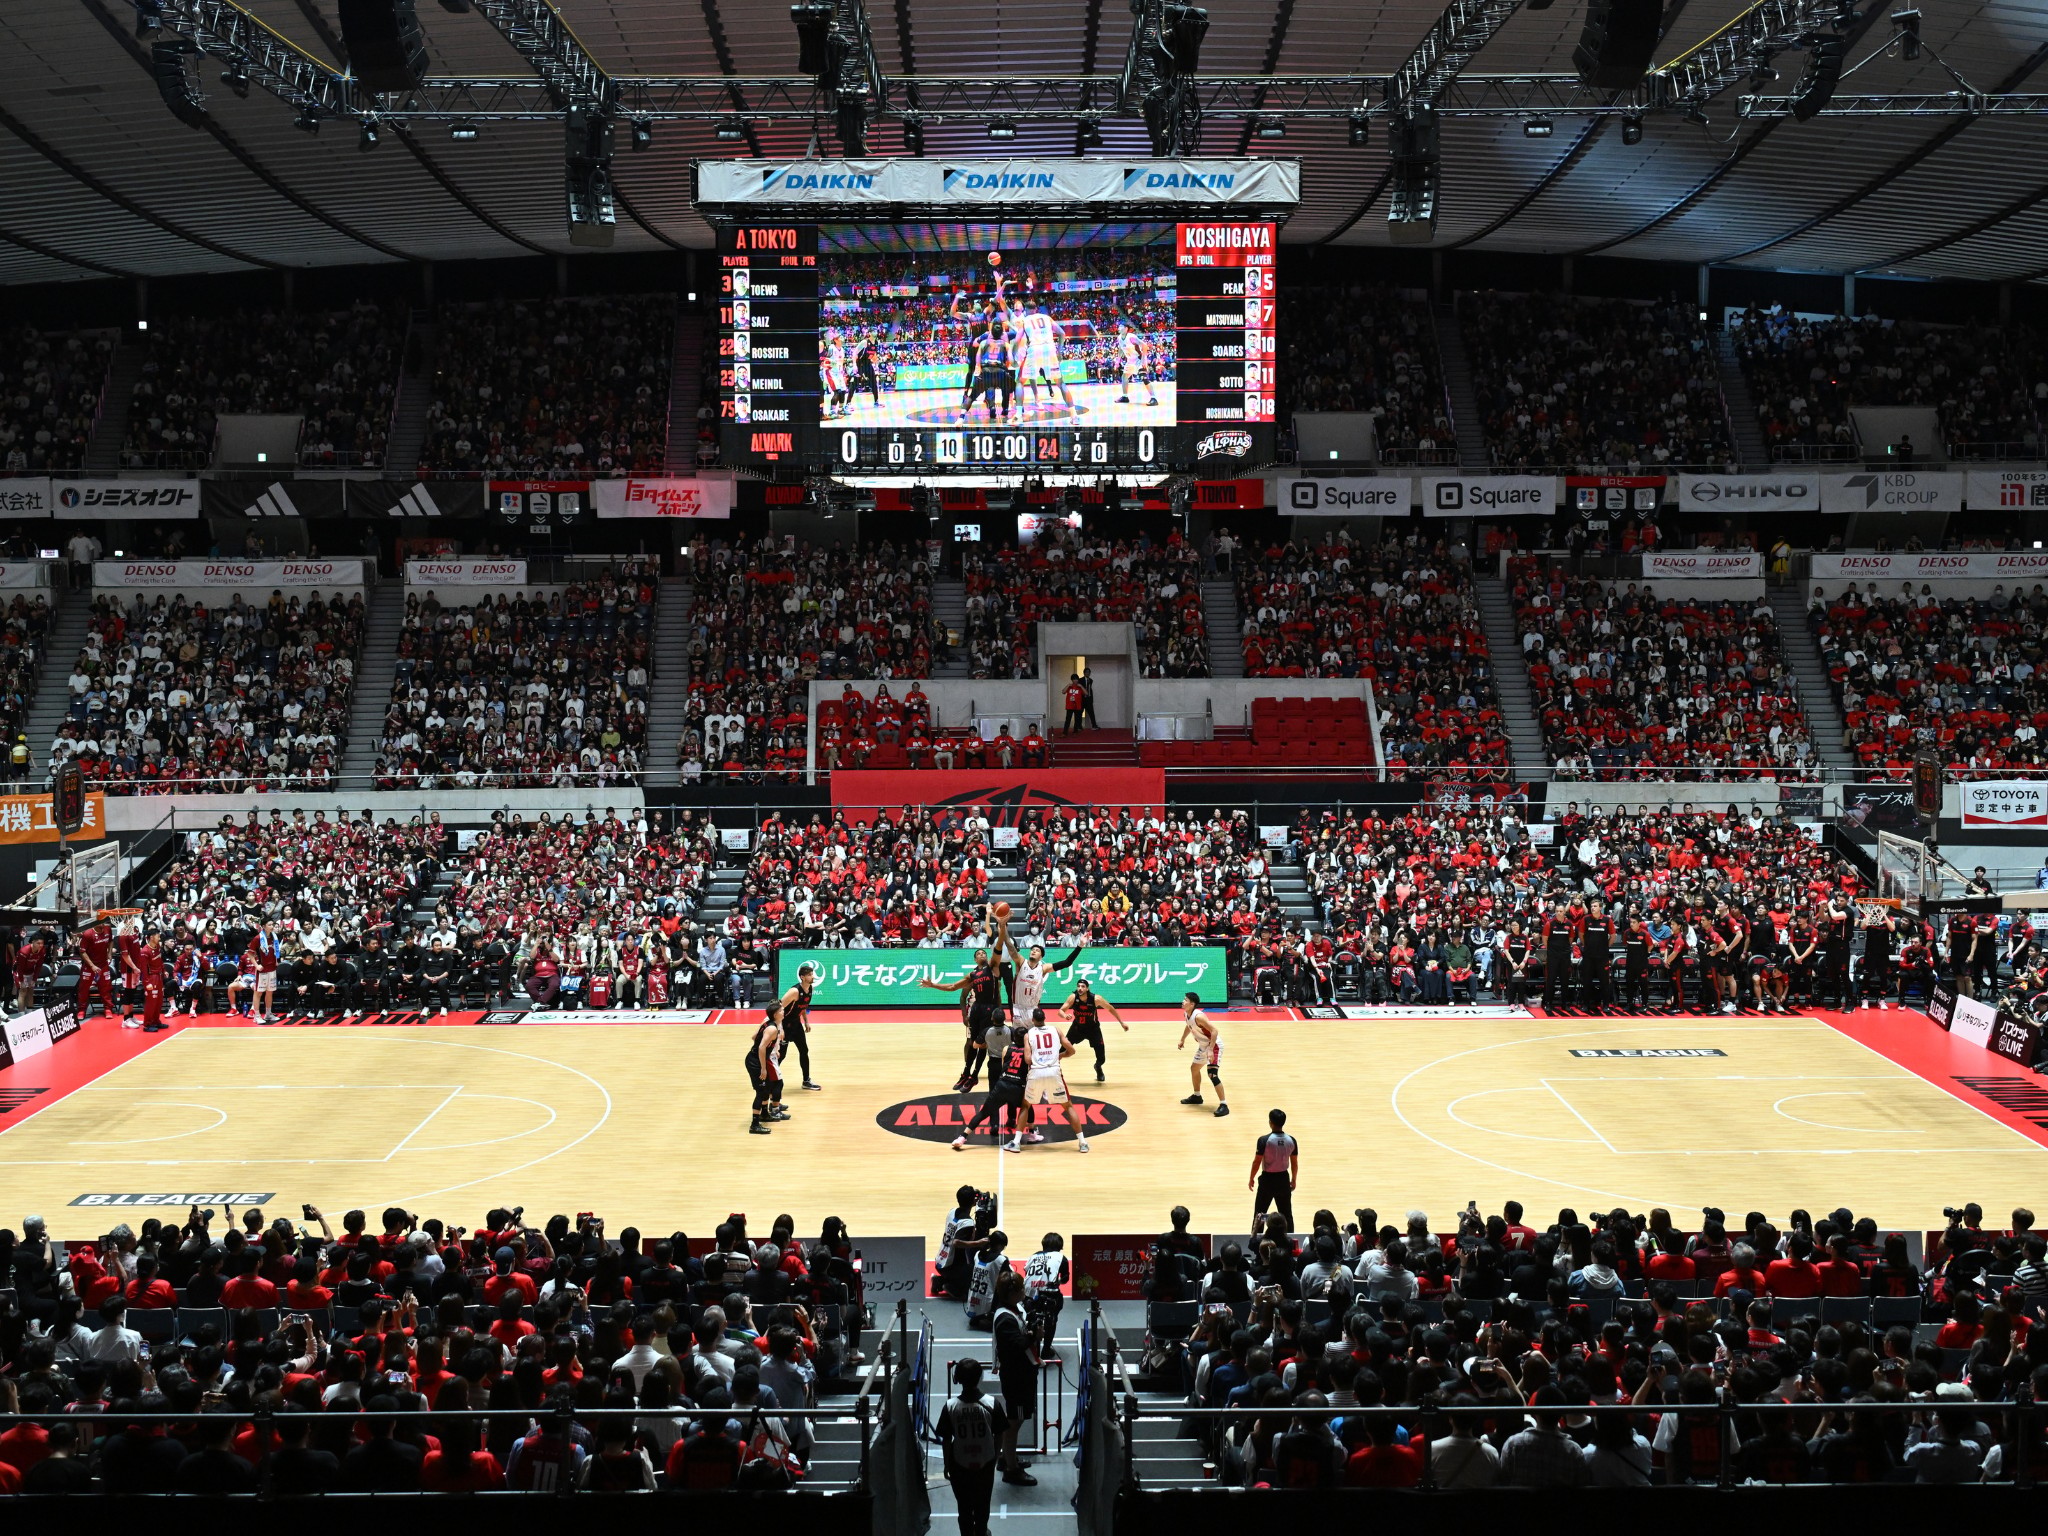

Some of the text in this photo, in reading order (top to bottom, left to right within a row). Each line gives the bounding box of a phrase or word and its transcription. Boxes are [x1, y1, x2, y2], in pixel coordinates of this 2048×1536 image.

[785, 174, 873, 190] DAIKIN
[965, 173, 1055, 189] DAIKIN
[1145, 173, 1235, 190] DAIKIN
[736, 229, 797, 249] A TOKYO
[1186, 227, 1271, 248] KOSHIGAYA
[723, 256, 815, 266] PLAYER FOUL PTS
[1180, 255, 1272, 265] PTS FOUL PLAYER
[721, 275, 778, 296] 3 TOEWS
[1223, 273, 1274, 295] PEAK 5
[720, 307, 770, 328] 11 SAIZ
[1030, 317, 1046, 330] 10
[1206, 305, 1274, 326] MATSUYAMA 7
[720, 338, 789, 359] 22 ROSSITER
[1212, 336, 1275, 357] SOARES 10
[720, 369, 784, 390] 23 MEINDL
[1219, 367, 1274, 388] SOTTO 11
[720, 400, 790, 421] 75 OSAKABE
[1261, 398, 1275, 415] 18
[751, 432, 793, 452] ALVARK
[893, 433, 900, 442] F
[914, 433, 922, 442] T
[1073, 432, 1080, 441] T
[1096, 432, 1103, 441] F
[841, 430, 857, 463] 0
[893, 444, 901, 462] 0
[914, 444, 922, 462] 2
[941, 438, 957, 459] 1Q
[972, 435, 1027, 460] 10:00
[1038, 438, 1059, 460] 24
[1073, 443, 1081, 462] 2
[1095, 444, 1103, 461] 0
[1138, 430, 1154, 462] 0
[1198, 436, 1250, 457] ALPHAS
[1884, 475, 1916, 487] KBD
[83, 488, 194, 506] シミズオクト
[624, 480, 700, 502] トヨタイムズ
[1324, 486, 1397, 510] Square
[1469, 484, 1542, 509] Square
[1724, 482, 1808, 499] HINO
[1884, 491, 1939, 505] GROUP
[656, 502, 702, 517] スポーツ
[282, 564, 333, 575] DENSO
[418, 564, 463, 574] DENSO
[472, 564, 516, 574] DENSO
[1652, 557, 1697, 567] DENSO
[1706, 557, 1751, 567] DENSO
[1840, 557, 1891, 568] DENSO
[1918, 557, 1969, 568] DENSO
[1997, 556, 2048, 567] DENSO
[124, 565, 177, 576] DENSO
[203, 565, 255, 576] DENSO
[1442, 784, 1471, 793] ANDO
[1992, 790, 2040, 800] TOYOTA
[1975, 803, 2038, 813] 認定中古車
[1056, 962, 1209, 985] りそなグループ
[17, 1023, 45, 1043] りそなグループ
[1035, 1033, 1053, 1050] 10
[1576, 1049, 1720, 1057] B.LEAGUE
[2005, 1038, 2024, 1058] LIVE
[894, 1103, 1111, 1126] ALVRK
[78, 1193, 266, 1206] B.LEAGUE
[1510, 1232, 1525, 1250] 7
[1092, 1249, 1112, 1262] 元気
[1027, 1264, 1052, 1277] 024
[959, 1422, 986, 1439] 019
